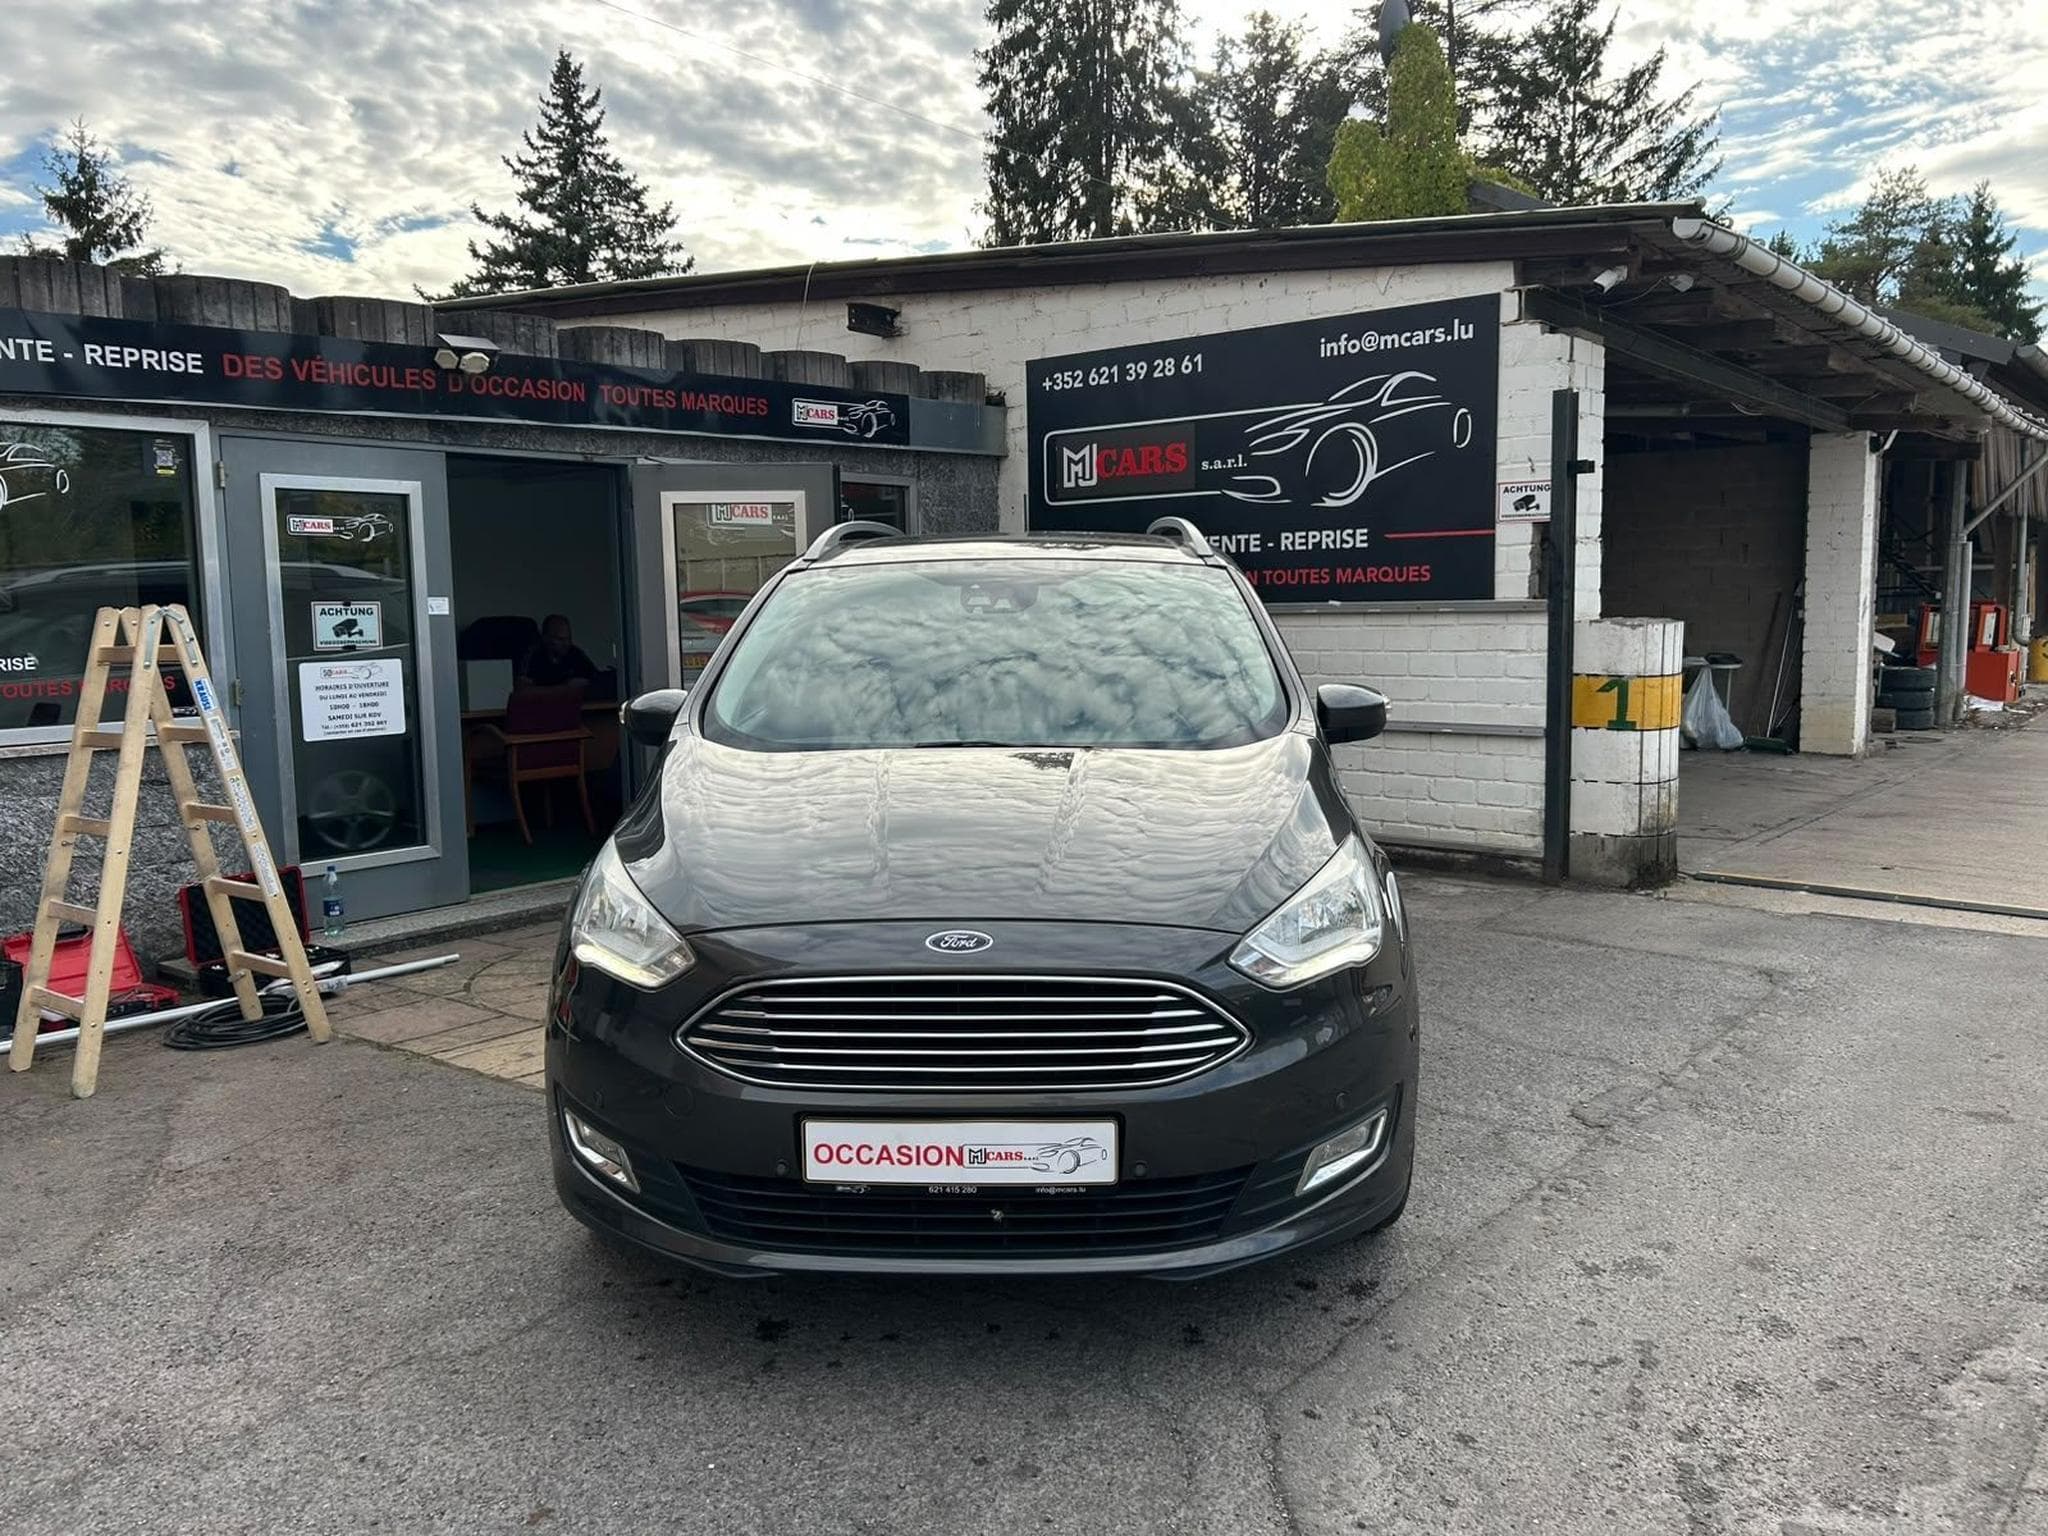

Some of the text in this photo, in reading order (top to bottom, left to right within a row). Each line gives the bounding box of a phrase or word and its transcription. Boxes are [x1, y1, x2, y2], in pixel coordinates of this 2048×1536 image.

[1319, 318, 1475, 358] info@mcars.lu
[84, 343, 204, 375] REPRISE
[223, 353, 284, 381] DES
[291, 355, 437, 390] VÉHICULES
[600, 384, 676, 410] TOUTES
[682, 391, 769, 416] MARQUES
[1042, 353, 1203, 391] +352 621 39 28 61
[1201, 454, 1248, 470] s.a.r.l.
[1503, 484, 1551, 494] ACHTUNG
[1204, 533, 1261, 553] ENTE
[1280, 528, 1369, 551] REPRISE
[1263, 567, 1330, 585] TOUTES
[1335, 565, 1431, 584] MARQUES
[319, 607, 374, 617] ACHTUNG
[1596, 678, 1637, 730] 1
[940, 934, 978, 948] Ford
[813, 1143, 963, 1167] OCCASION
[928, 1185, 943, 1194] 621
